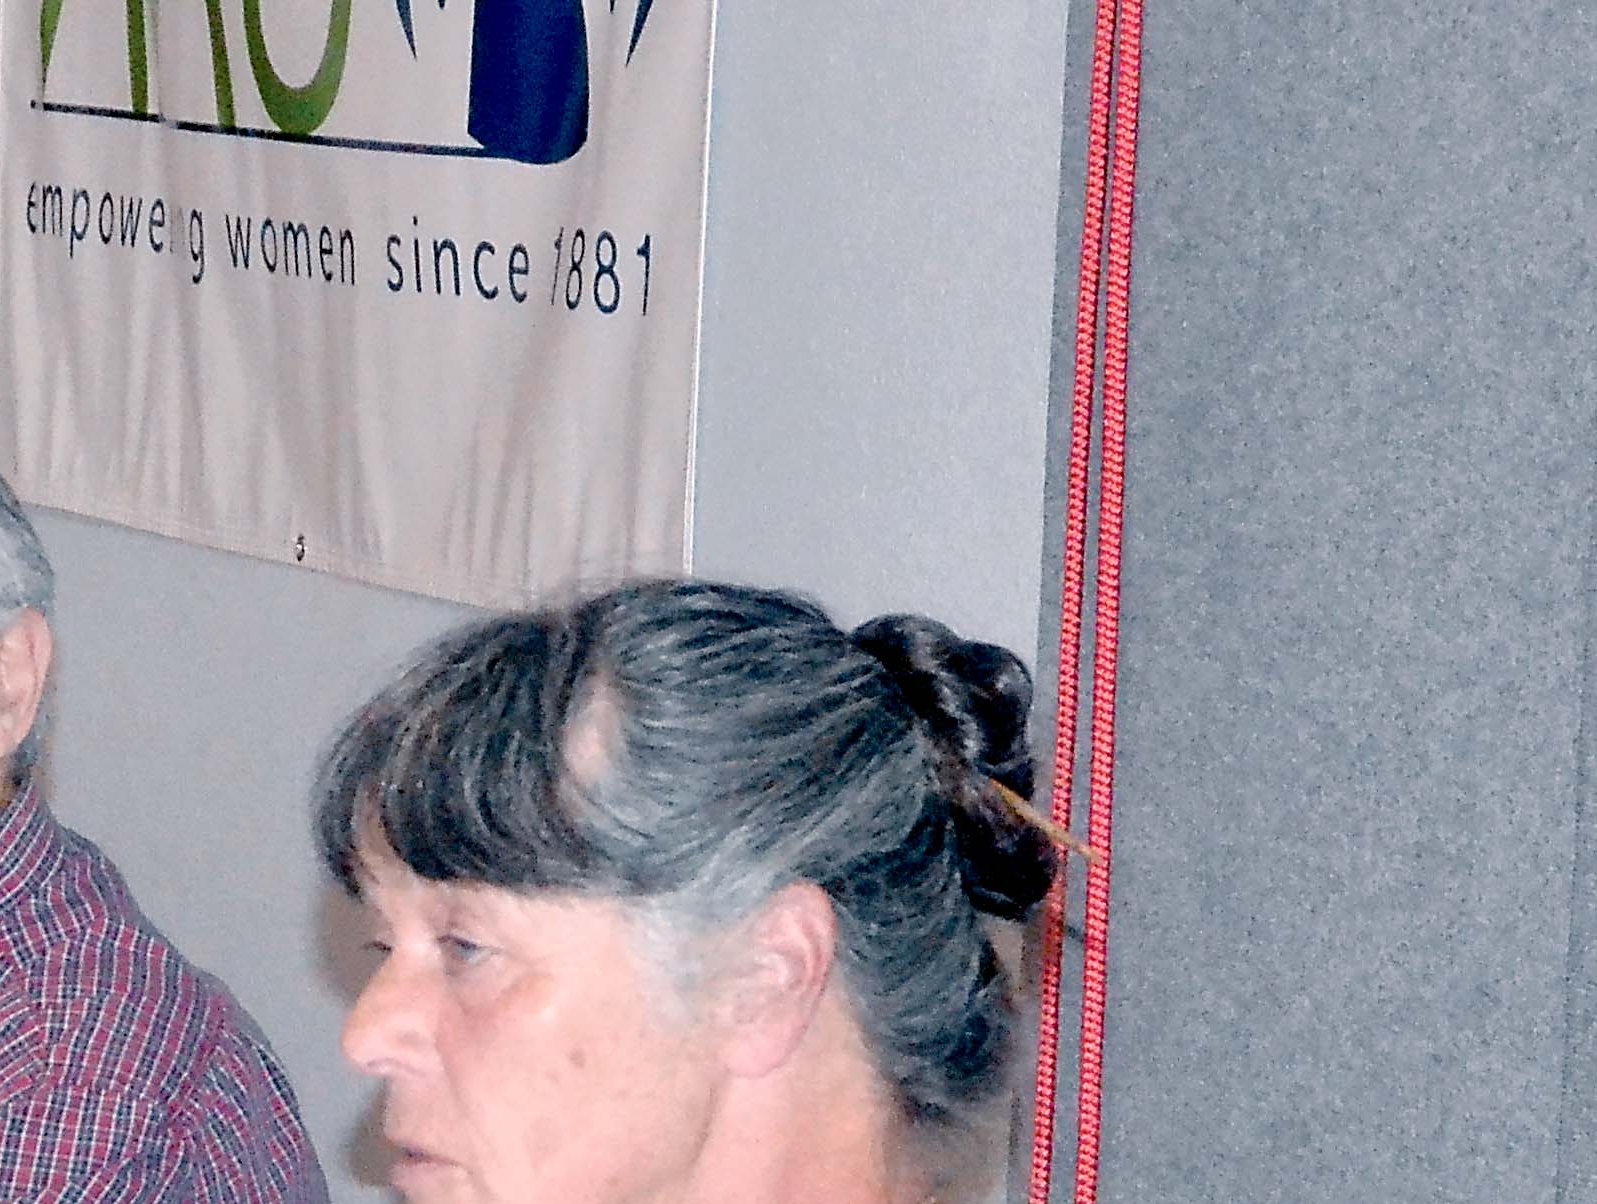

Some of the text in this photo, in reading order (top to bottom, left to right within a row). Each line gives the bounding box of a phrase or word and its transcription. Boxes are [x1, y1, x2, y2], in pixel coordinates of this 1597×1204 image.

[26, 181, 651, 317] empoweg women since 1881
